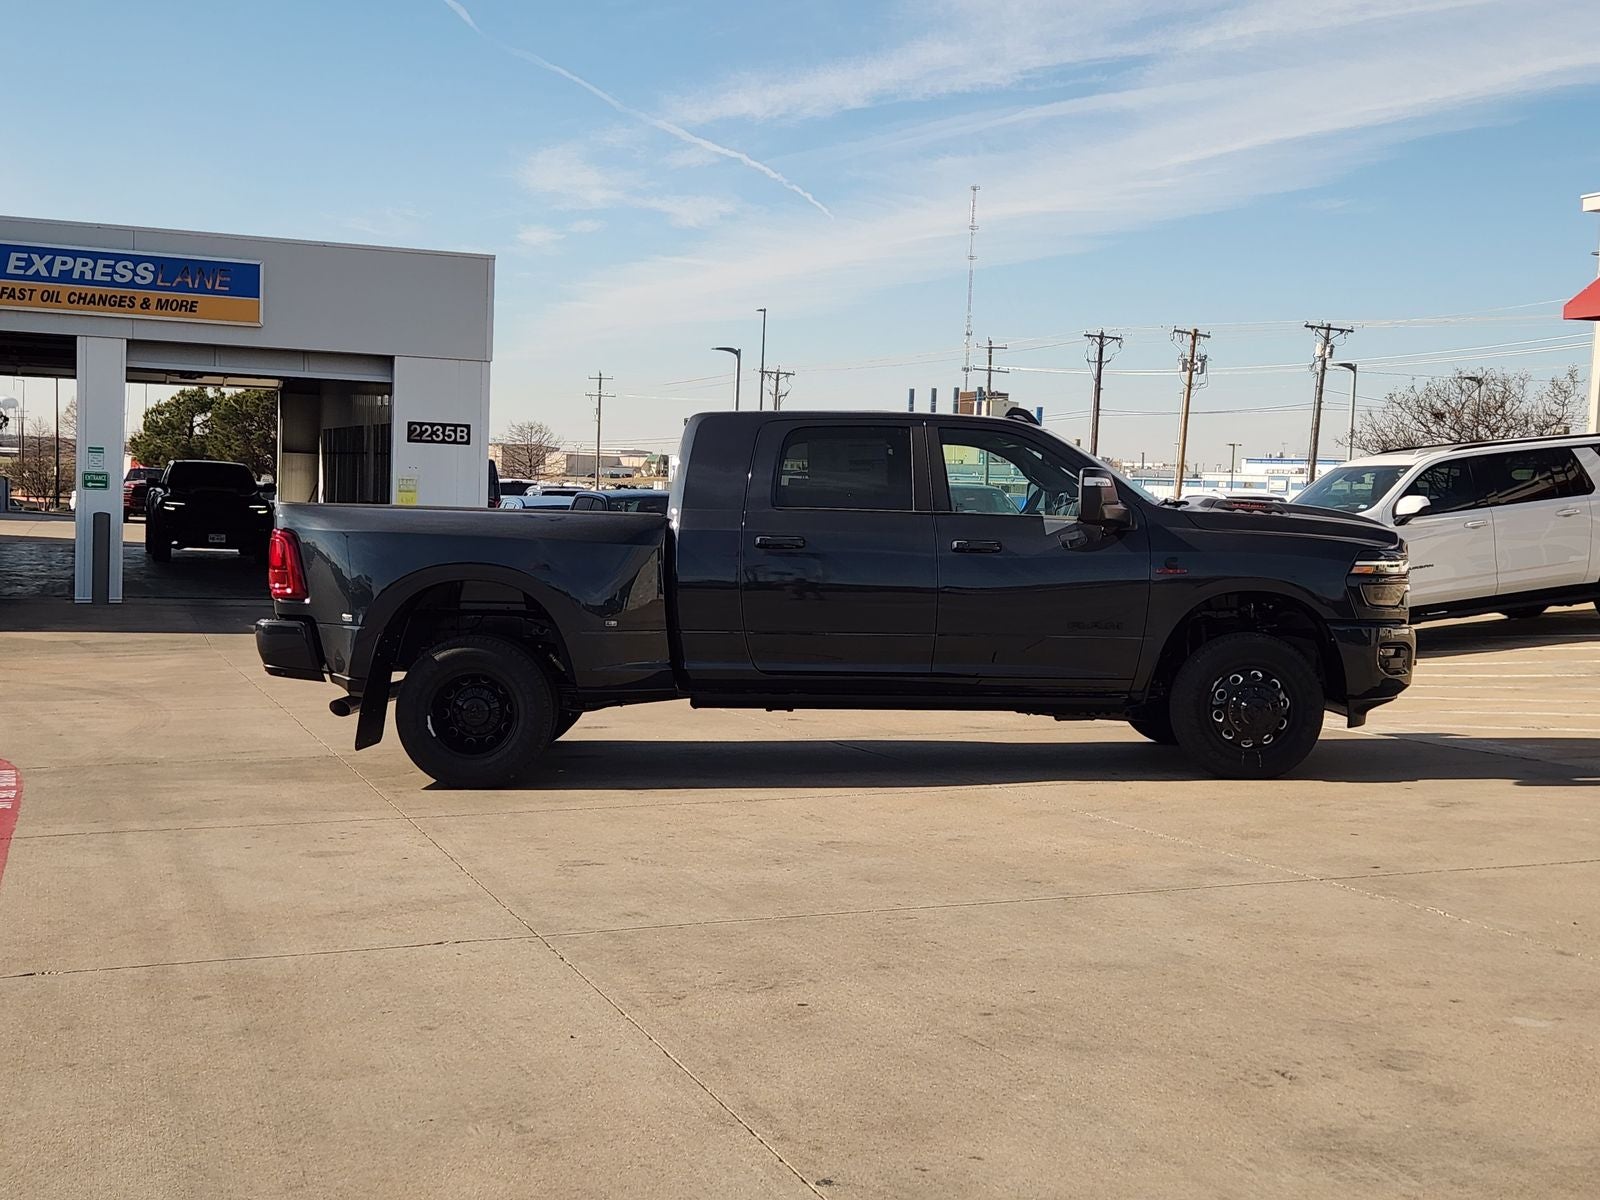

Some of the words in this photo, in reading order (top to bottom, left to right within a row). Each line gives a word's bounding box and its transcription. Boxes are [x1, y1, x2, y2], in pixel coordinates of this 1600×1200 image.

[0, 286, 37, 301] FAST
[40, 289, 62, 303] OIL
[67, 291, 136, 309] CHANGES
[140, 298, 152, 310] &
[155, 298, 199, 313] MORE
[410, 424, 468, 442] 2235B
